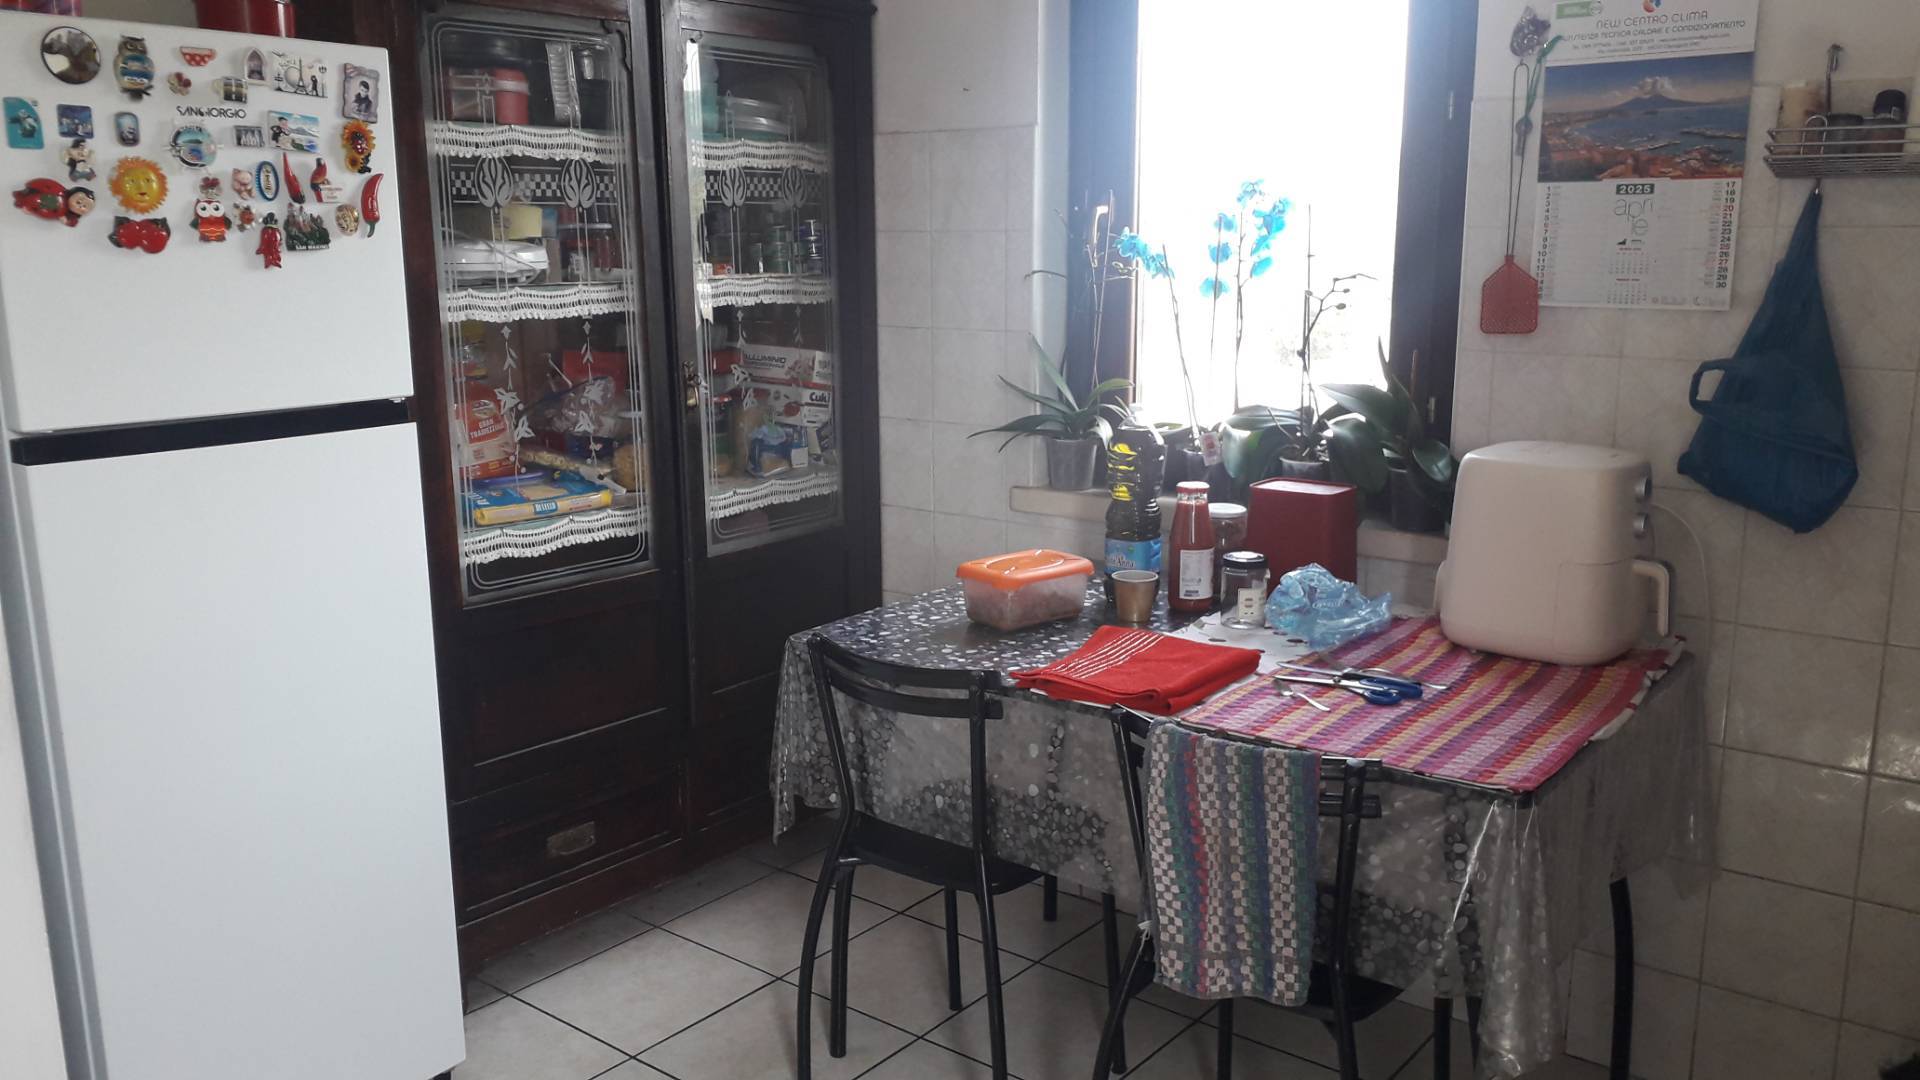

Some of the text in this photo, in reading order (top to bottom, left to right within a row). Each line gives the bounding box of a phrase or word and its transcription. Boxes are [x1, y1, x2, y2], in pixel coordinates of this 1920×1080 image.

[1596, 10, 1708, 28] NEW CENTRO CLIMA
[1672, 20, 1746, 33] CONDIZIONAMENTO
[1619, 185, 1651, 194] 2025
[809, 391, 831, 403] Cuki
